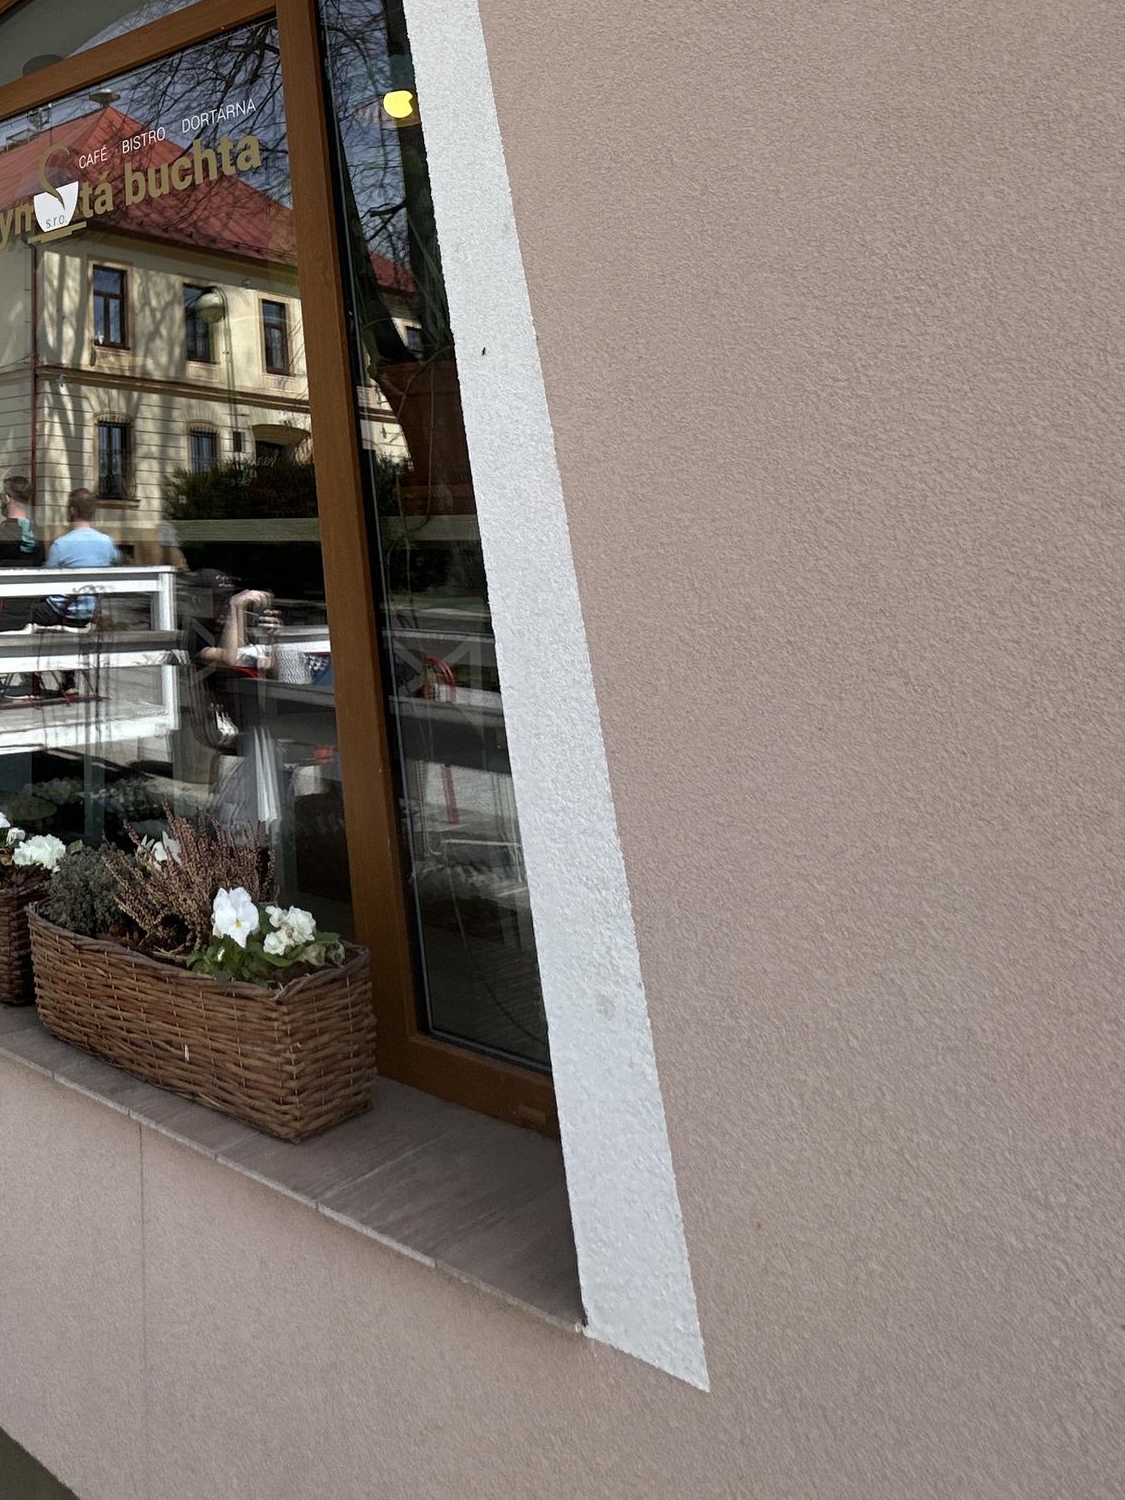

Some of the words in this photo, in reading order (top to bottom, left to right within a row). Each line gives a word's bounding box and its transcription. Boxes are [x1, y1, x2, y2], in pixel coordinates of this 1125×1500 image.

[78, 145, 108, 170] CAFÉ
[122, 126, 166, 155] BISTRO
[125, 135, 263, 206] buchta
[45, 214, 68, 229] s.r.o.
